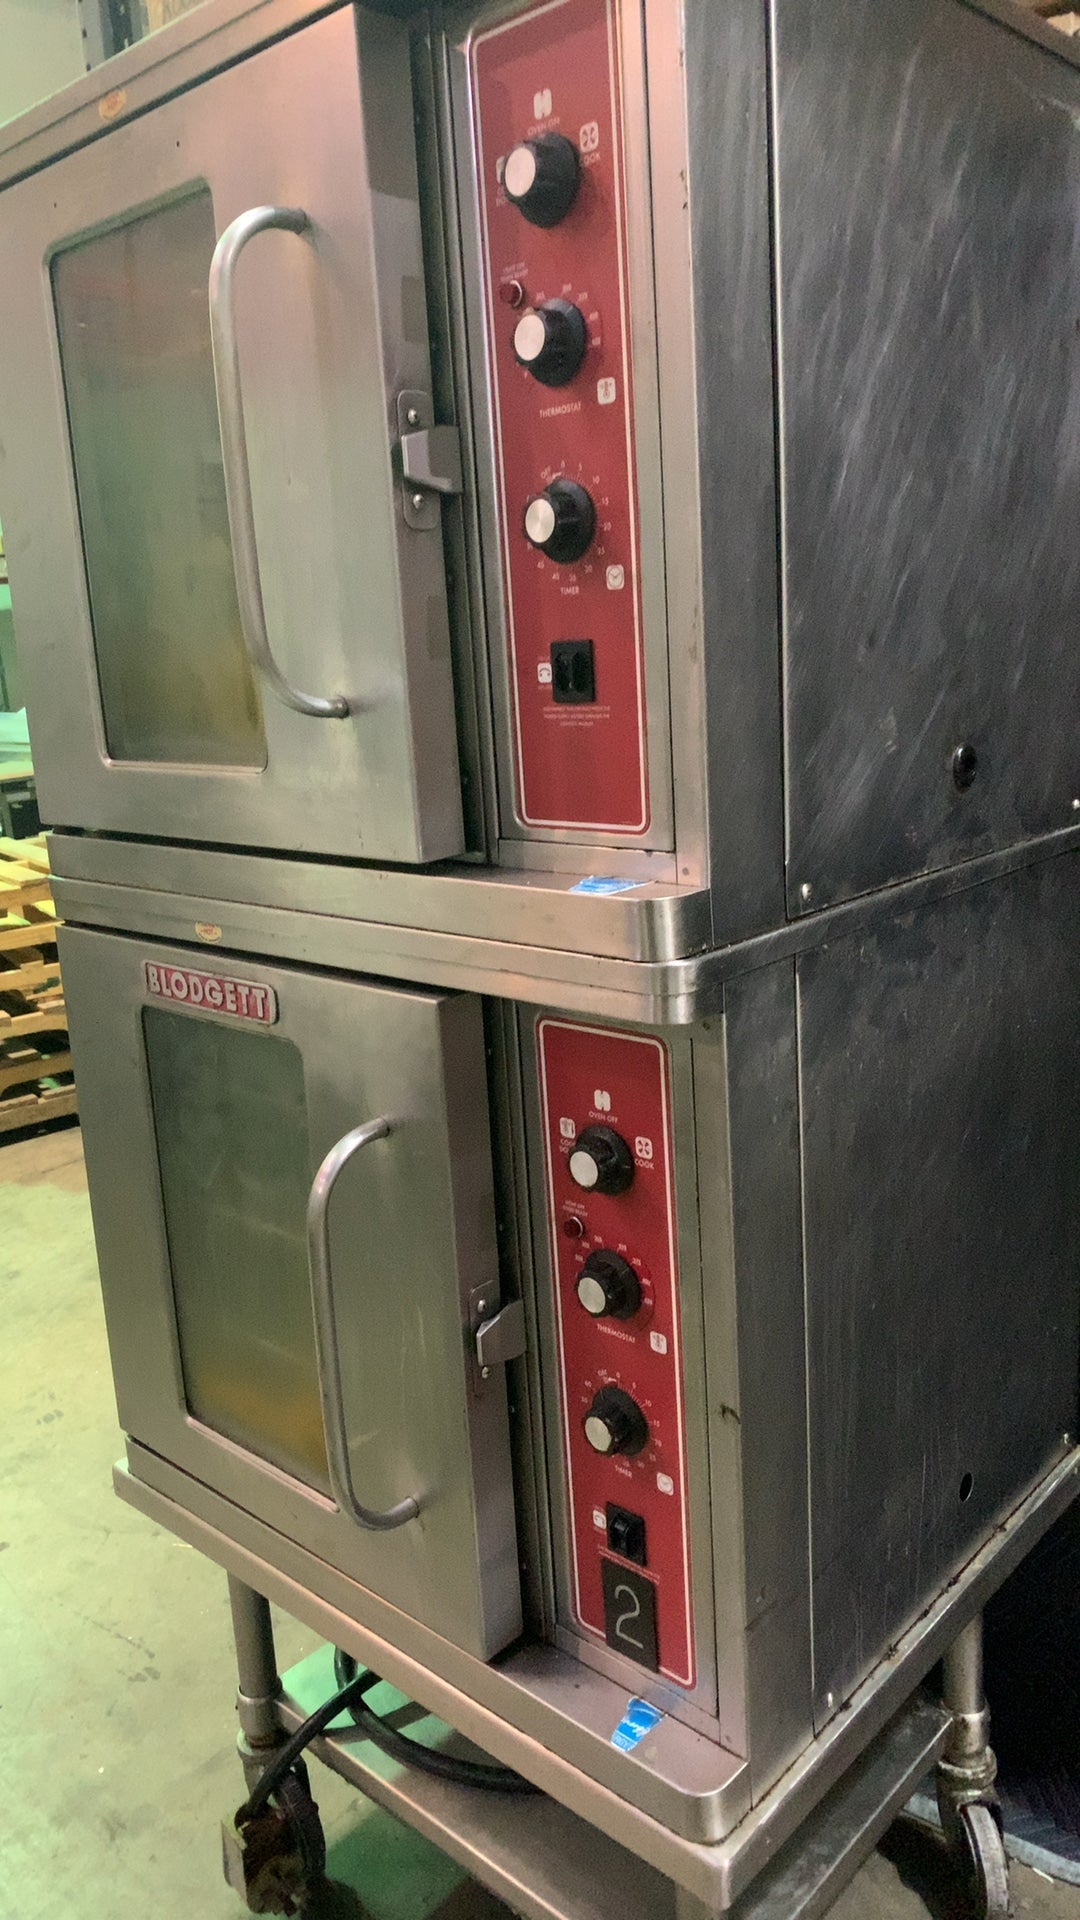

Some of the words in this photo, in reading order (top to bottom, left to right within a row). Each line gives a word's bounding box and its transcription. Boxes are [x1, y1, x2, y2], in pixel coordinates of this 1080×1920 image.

[539, 401, 582, 418] THERMOSTAT
[602, 496, 609, 506] 15
[560, 585, 580, 596] TIMER
[148, 964, 265, 1018] BLODGETT
[588, 1110, 606, 1120] OVEN
[607, 1115, 618, 1124] OFF
[634, 1158, 655, 1170] COOK
[597, 1323, 636, 1344] THERMOSTAT
[614, 1464, 633, 1480] TIMER
[614, 1584, 644, 1649] 2
